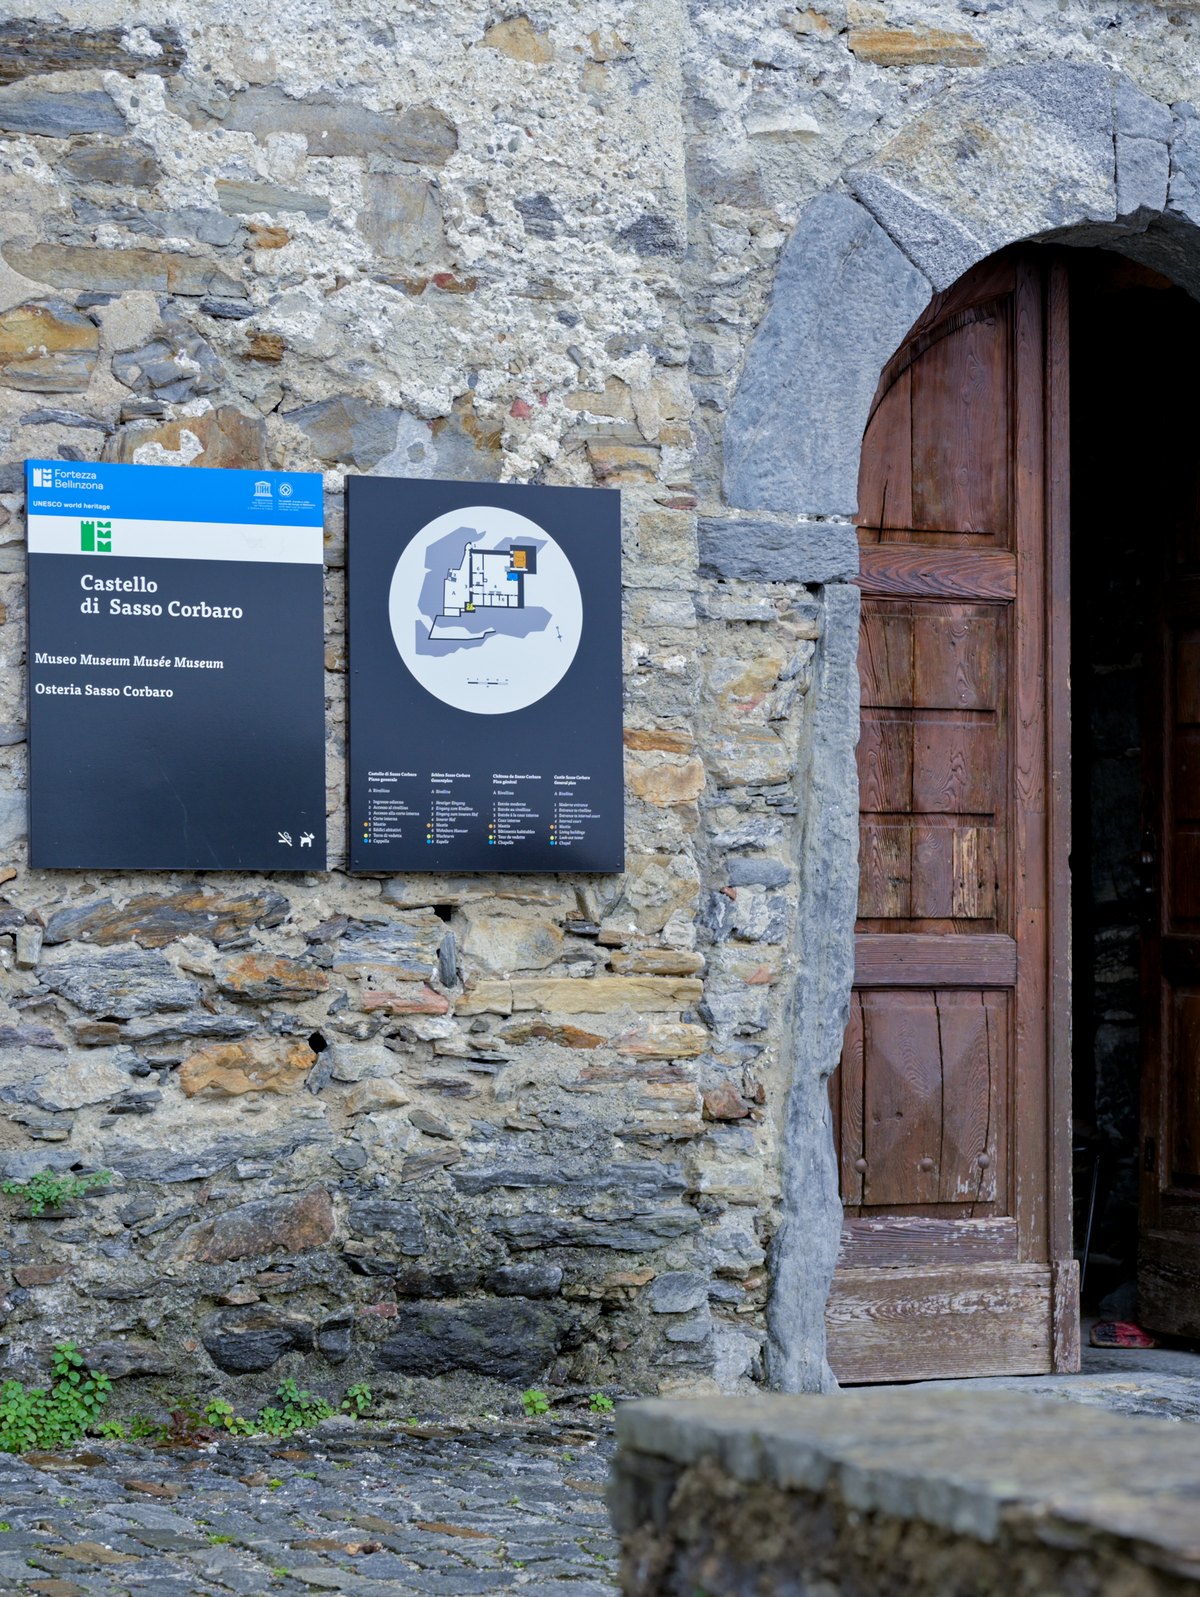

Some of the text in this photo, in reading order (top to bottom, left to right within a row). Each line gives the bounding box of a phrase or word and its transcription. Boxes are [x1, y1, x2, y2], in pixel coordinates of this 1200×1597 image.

[54, 468, 96, 480] Fortezza
[54, 479, 104, 490] Bellinzona
[80, 574, 158, 593] Castello
[80, 597, 243, 619] di Sasso Corbaro
[35, 652, 224, 669] Museo Museum Musée Museum
[35, 683, 173, 698] Osteria Sasso Corbaro
